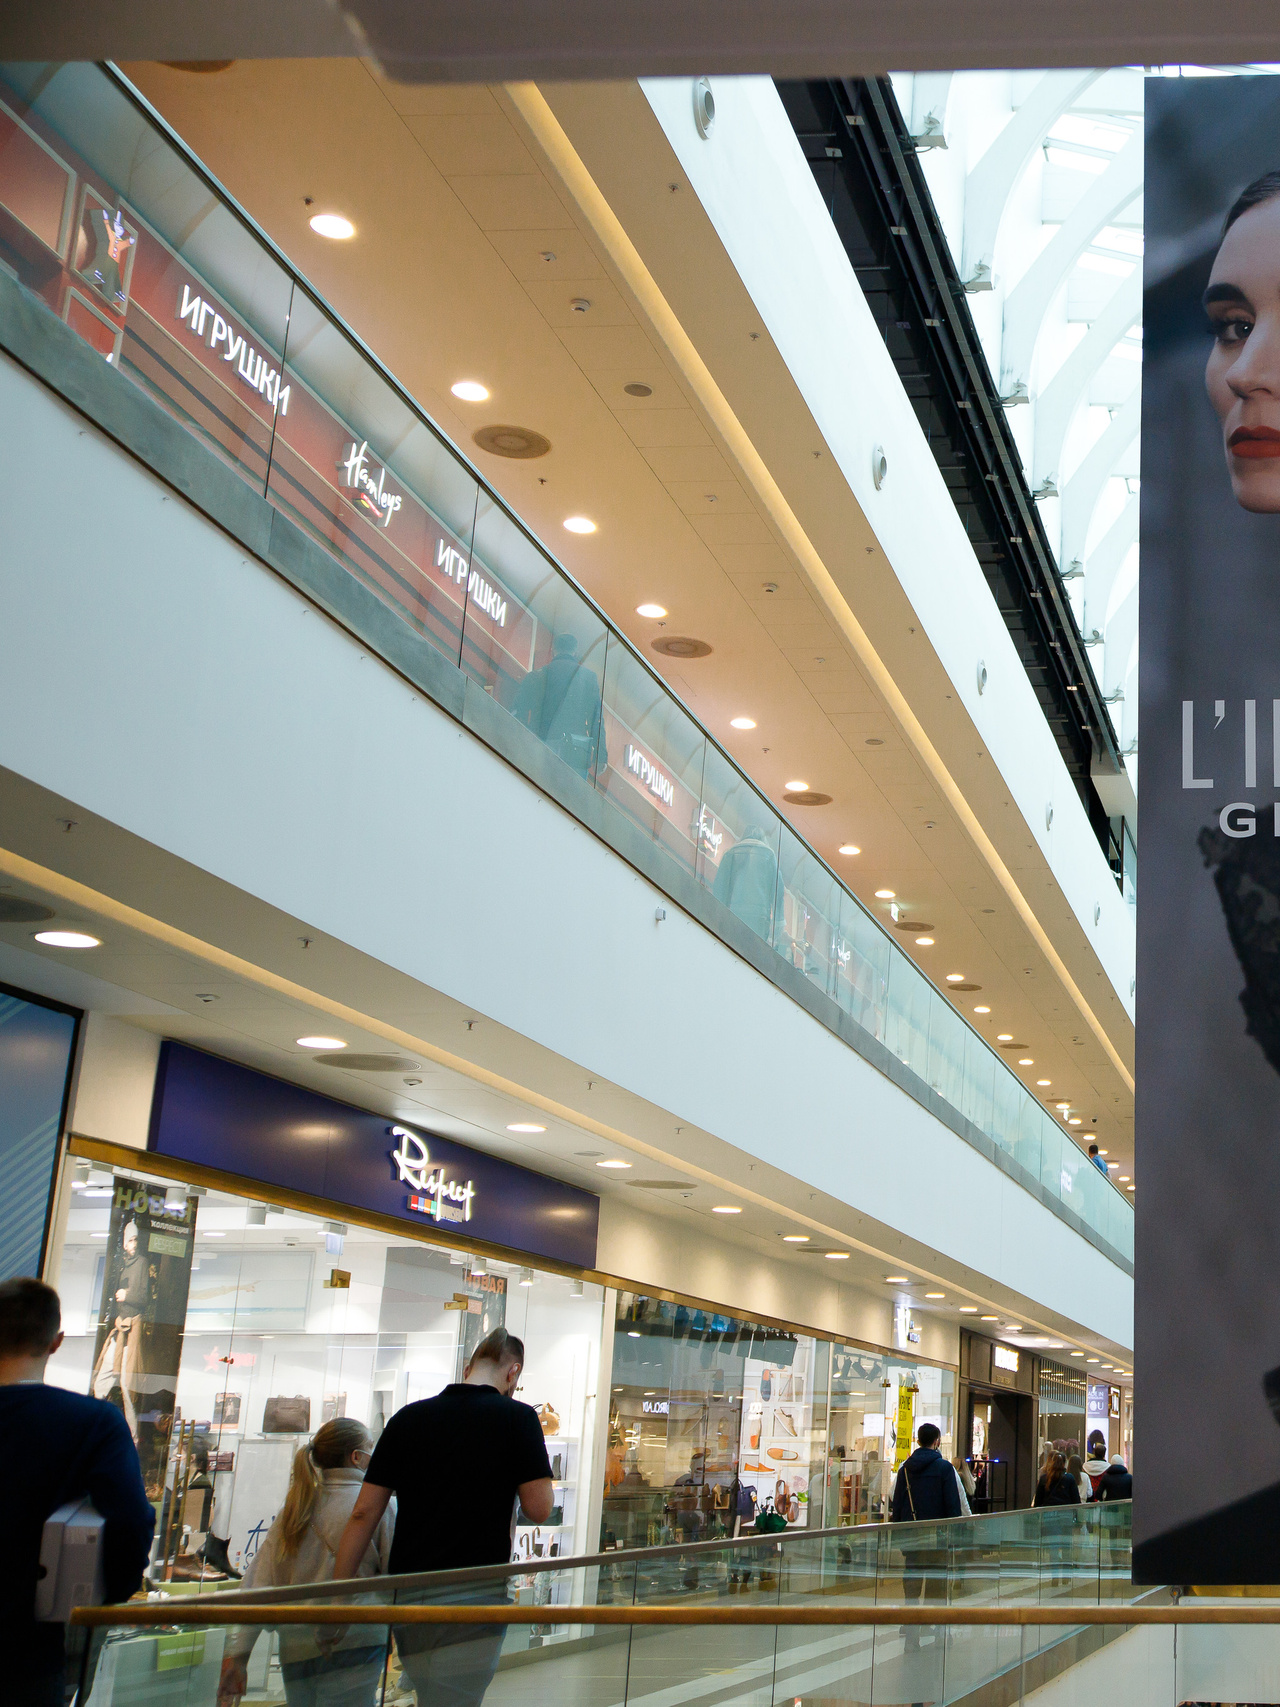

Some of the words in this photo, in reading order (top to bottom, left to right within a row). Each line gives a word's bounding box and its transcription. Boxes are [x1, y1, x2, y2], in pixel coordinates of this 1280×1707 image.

[180, 284, 291, 416] ИГРУШКИ
[344, 441, 402, 528] Hamleys
[437, 538, 507, 628] ИГРУШКИ
[628, 744, 674, 807] ИГРУШКИ
[392, 1125, 475, 1222] Respect
